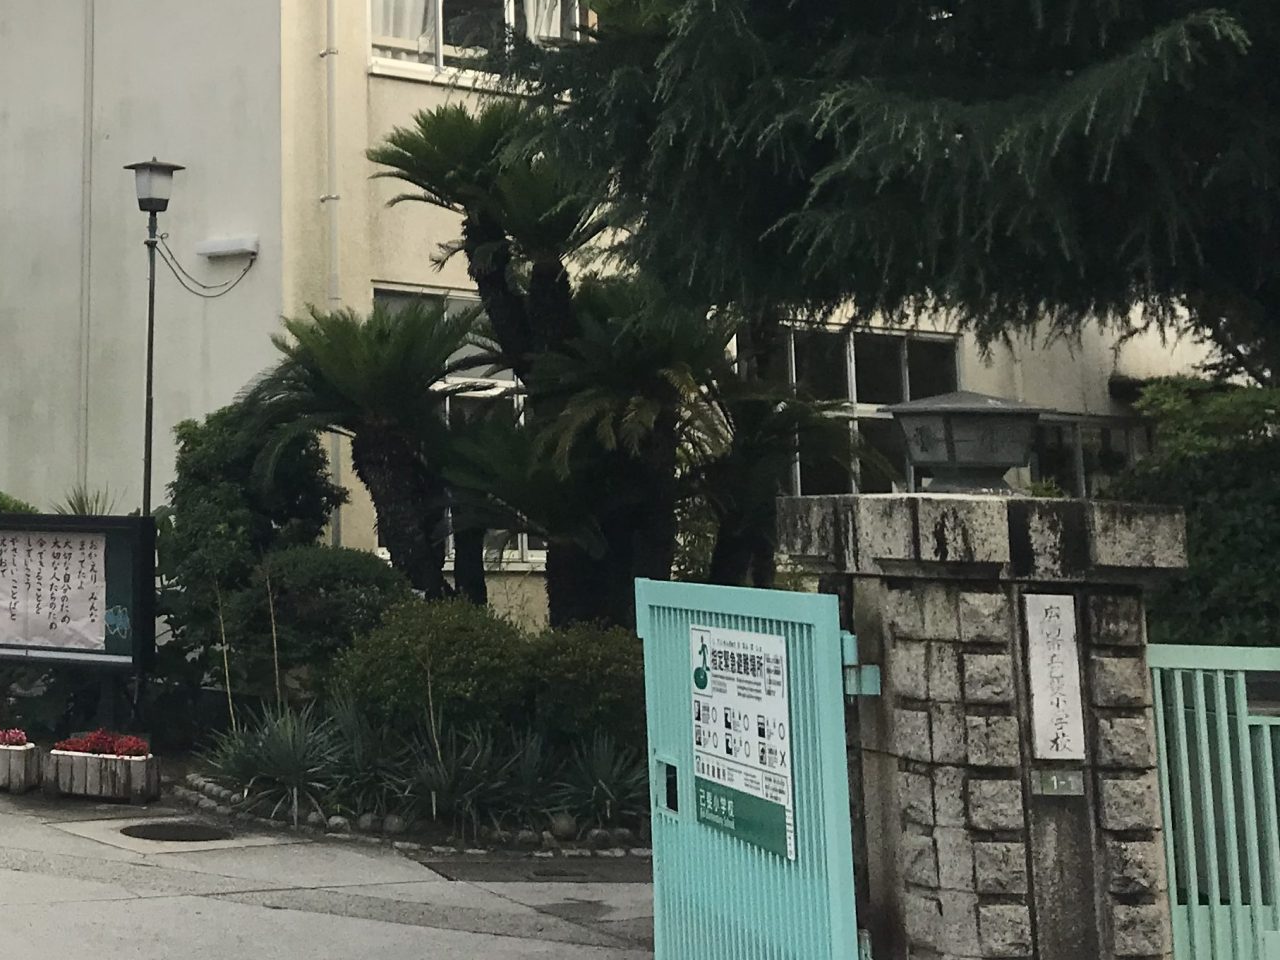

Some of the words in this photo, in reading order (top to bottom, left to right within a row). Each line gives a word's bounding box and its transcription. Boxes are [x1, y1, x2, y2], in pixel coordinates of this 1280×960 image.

[35, 539, 47, 615] 今できることを
[48, 537, 61, 630] 大切な人たちのため
[60, 538, 72, 625] 大切な自分のため
[77, 540, 86, 590] まってたよ
[1040, 605, 1072, 753] 広市立己斐小学校
